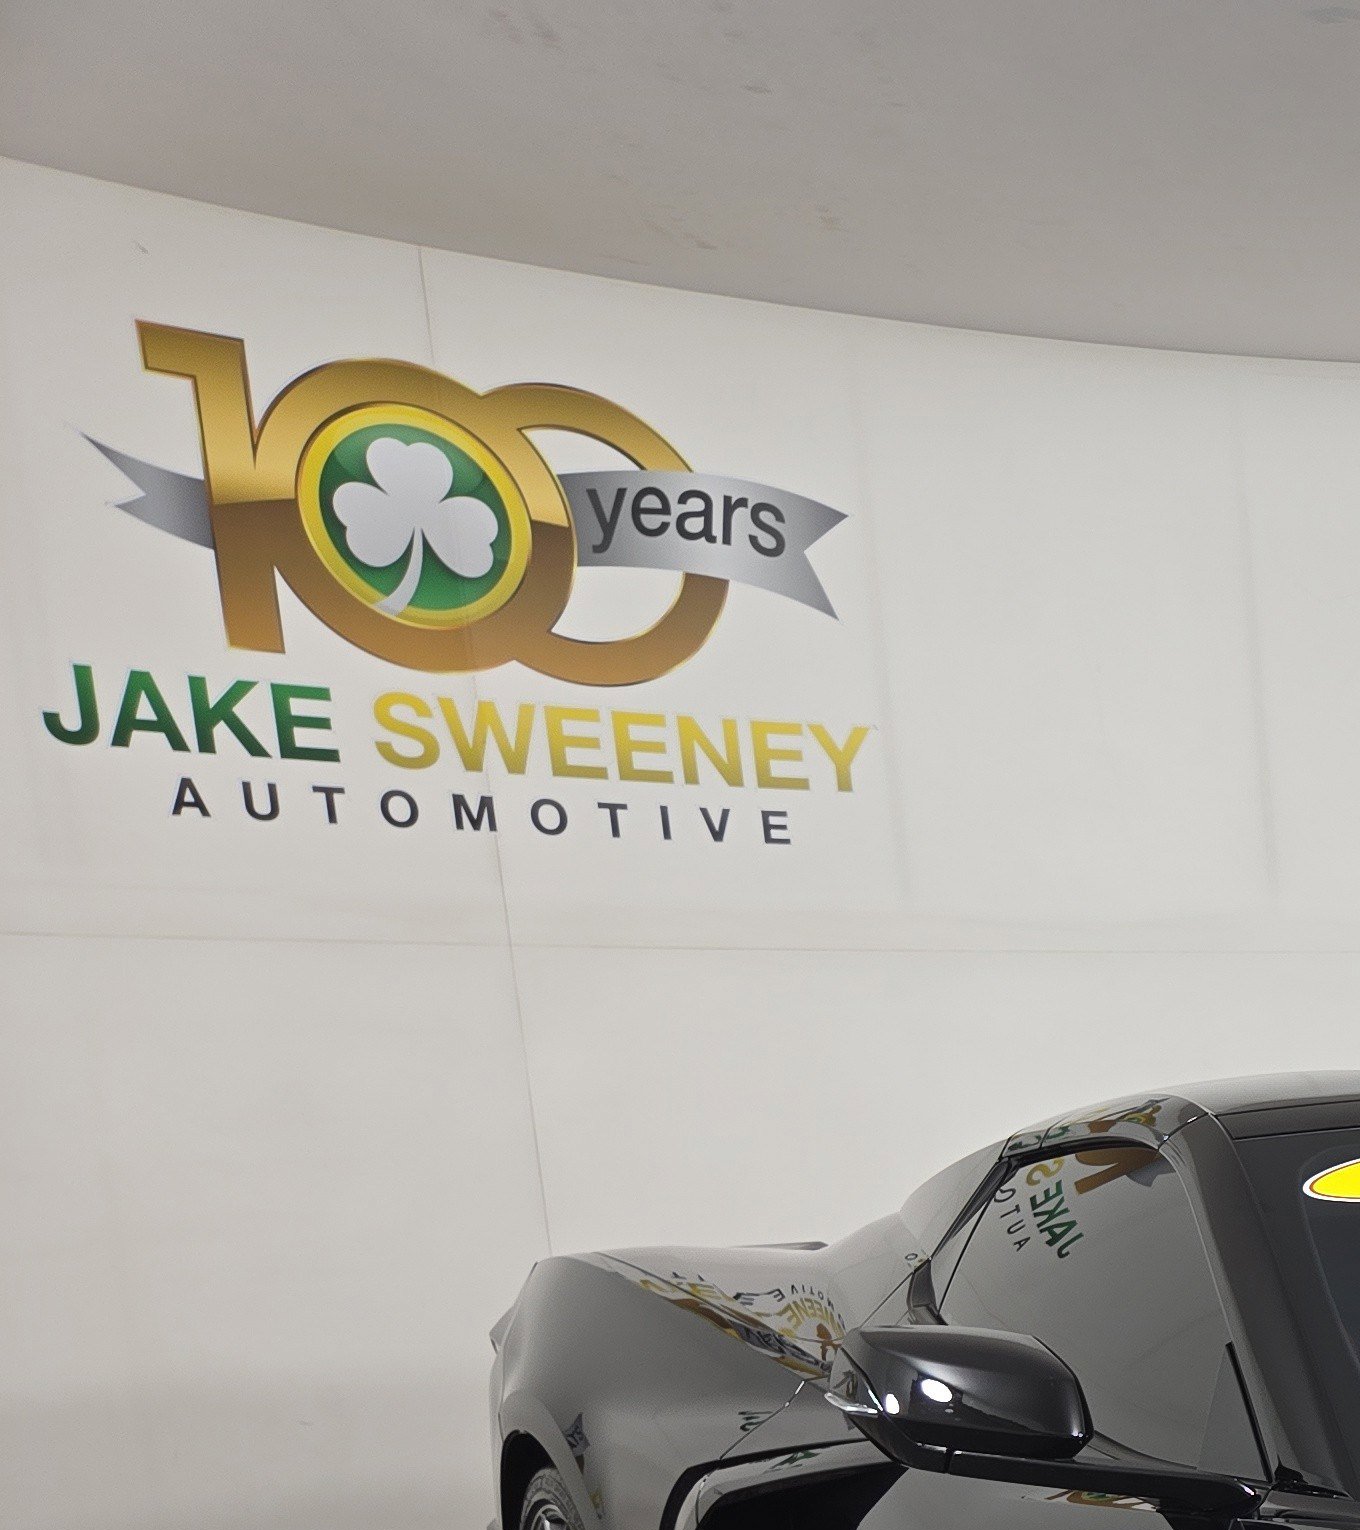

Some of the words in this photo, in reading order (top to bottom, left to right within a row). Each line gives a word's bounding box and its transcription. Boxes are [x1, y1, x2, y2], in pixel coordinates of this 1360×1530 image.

[586, 484, 788, 558] years
[42, 662, 342, 764] JAKE
[373, 693, 870, 794] SWEENEY
[172, 778, 792, 846] AUTOMOTIVE
